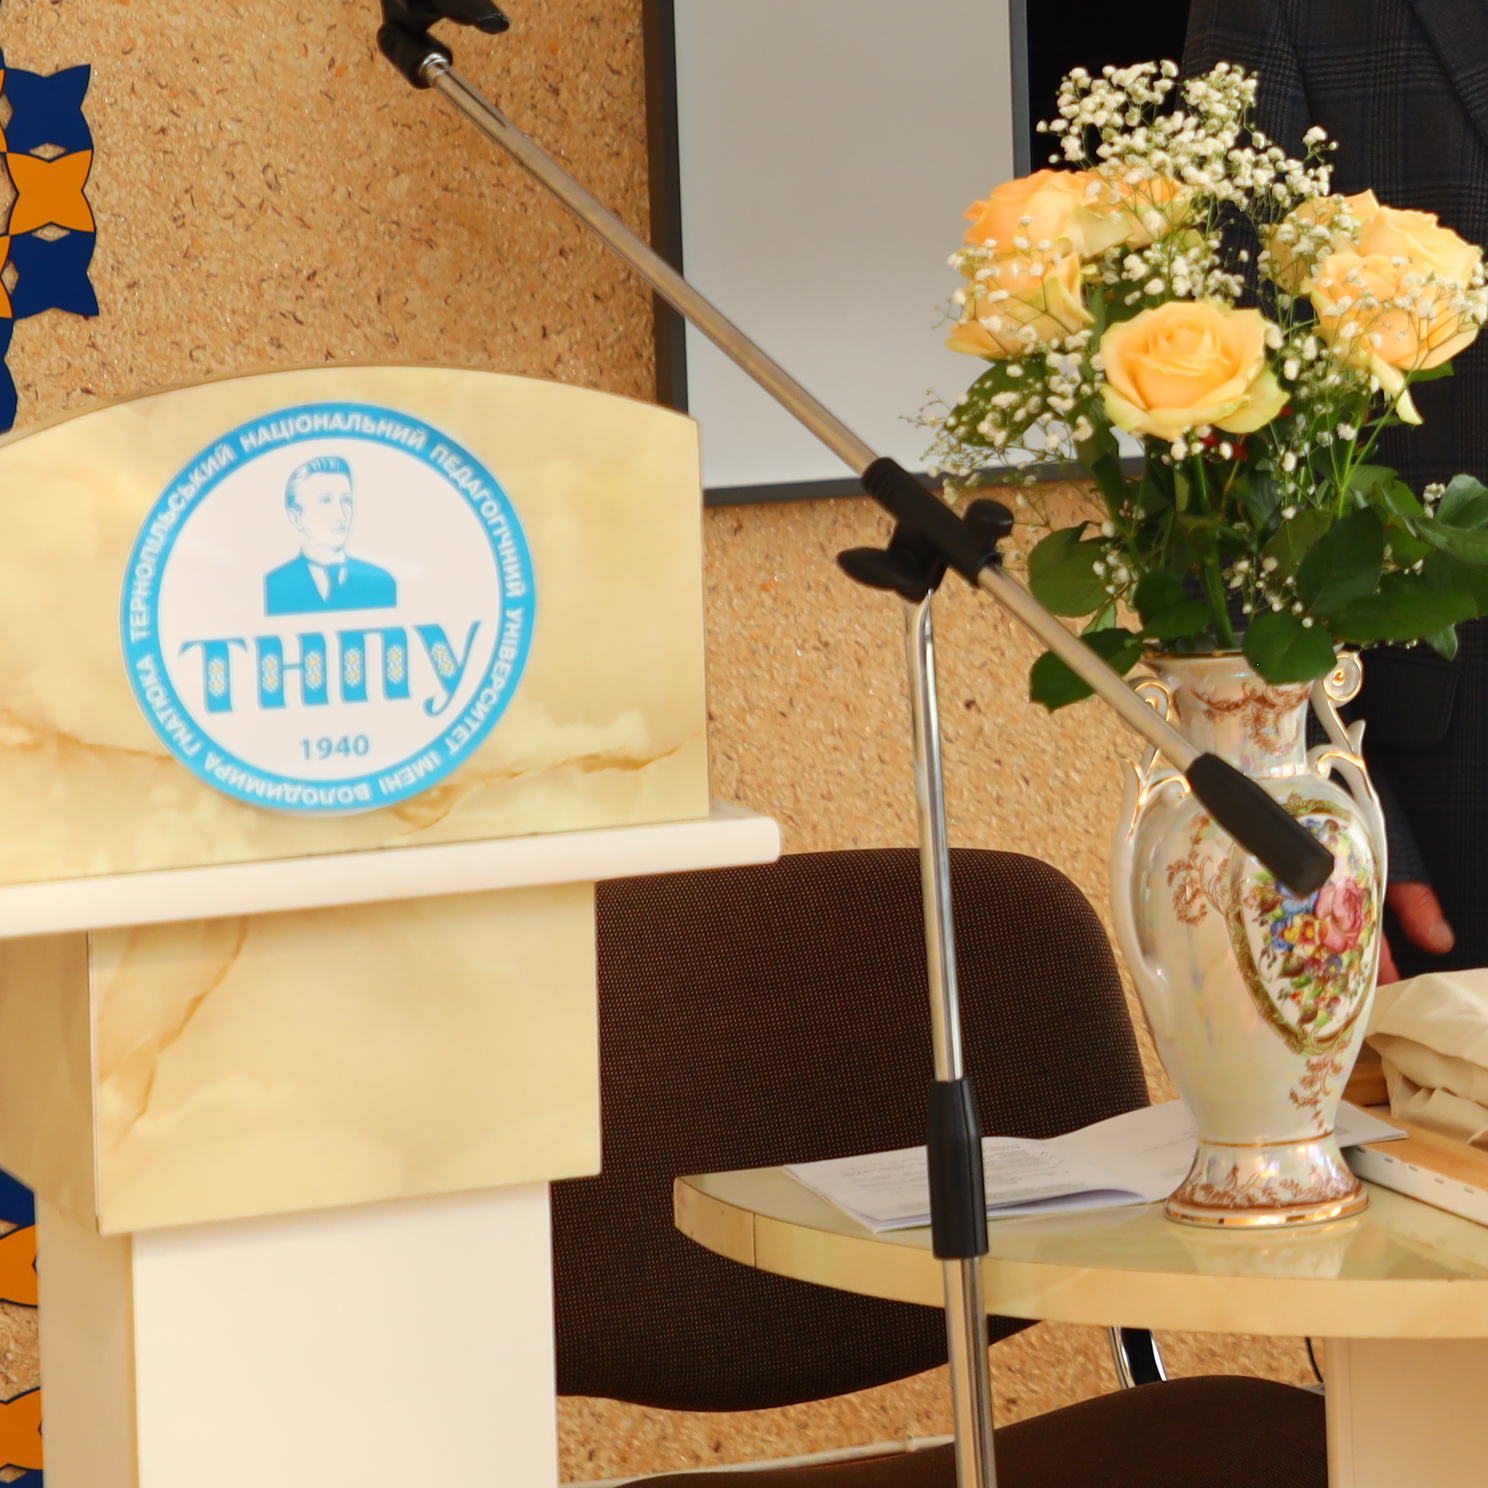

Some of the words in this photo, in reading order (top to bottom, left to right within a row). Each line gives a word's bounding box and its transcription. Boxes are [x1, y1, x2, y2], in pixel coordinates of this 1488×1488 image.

[238, 410, 429, 453] НАЦІОНАЛЬНИЙ
[130, 442, 237, 643] ТЕРНОПІЛЬСЬКИЙ
[429, 444, 526, 599] ПЕДАГОГІЧНИЙ
[133, 654, 203, 758] ГНАТЮКА
[177, 620, 482, 718] ТНПУ
[443, 607, 525, 758] УНІВЕРСИТЕТ
[202, 754, 373, 807] ВОЛОДИМИРА
[299, 733, 370, 763] 1940
[378, 751, 442, 797] ІМЕНІ
